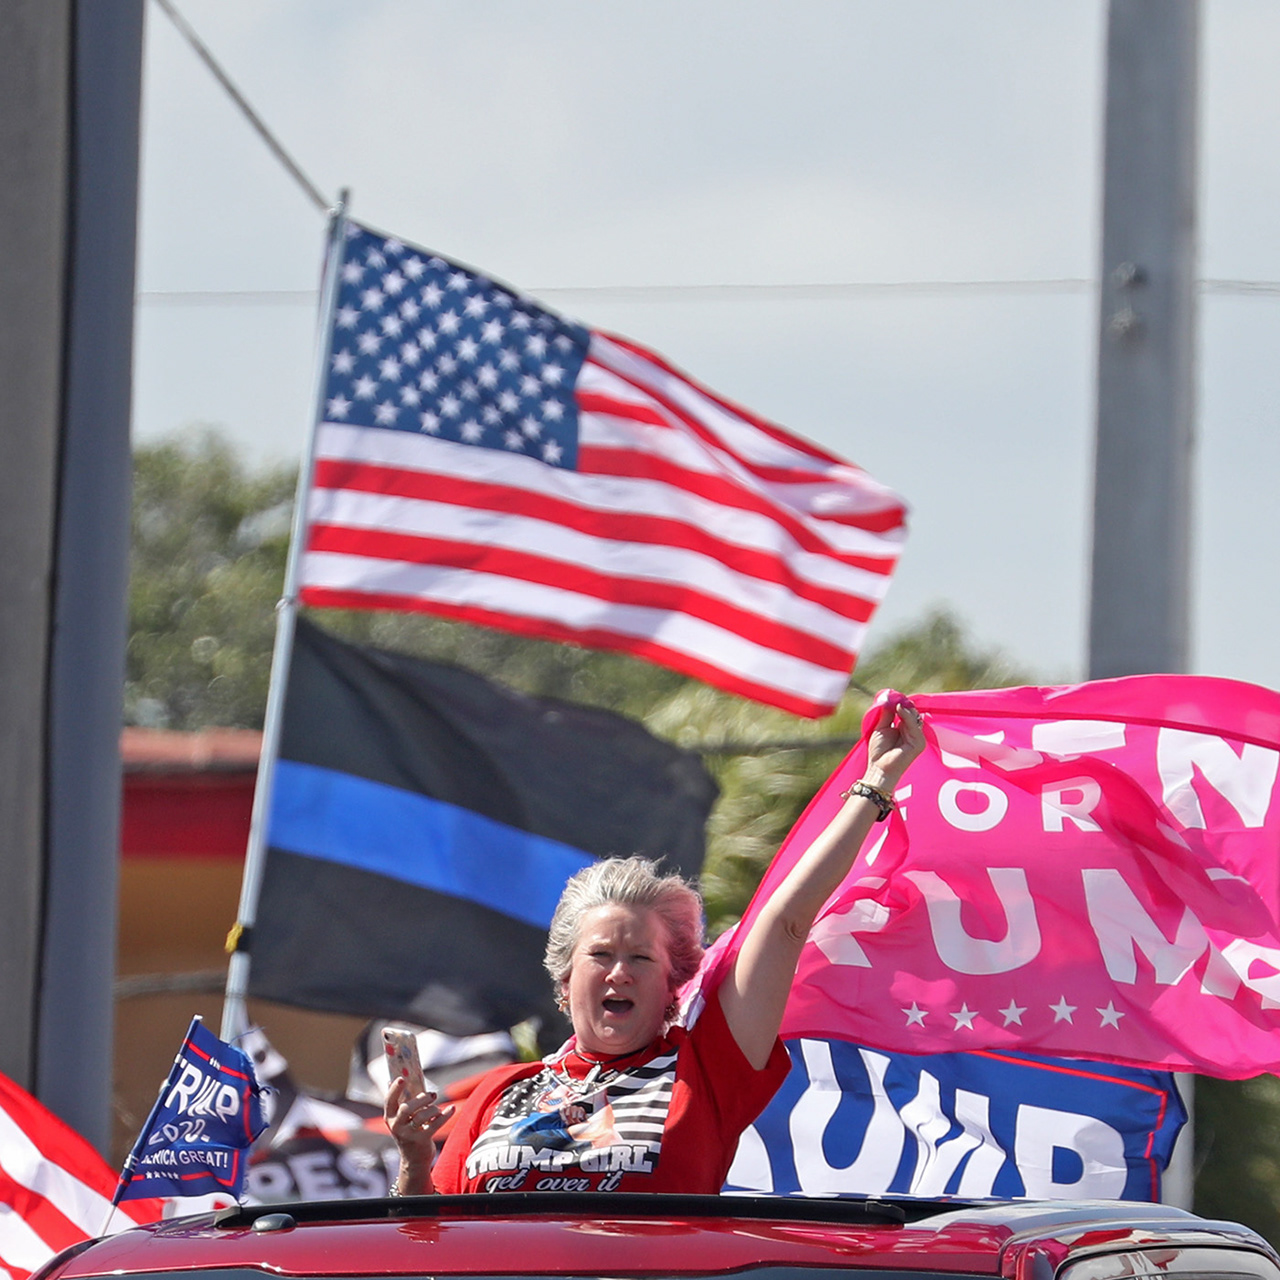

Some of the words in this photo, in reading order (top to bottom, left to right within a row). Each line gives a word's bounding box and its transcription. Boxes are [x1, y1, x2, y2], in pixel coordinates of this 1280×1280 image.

[720, 1037, 1129, 1199] UMP
[178, 1150, 228, 1168] GREAT!
[465, 1145, 574, 1179] TRUMP
[579, 1144, 654, 1173] GIRL
[485, 1168, 529, 1193] get
[535, 1175, 591, 1192] over
[596, 1171, 624, 1192] it
